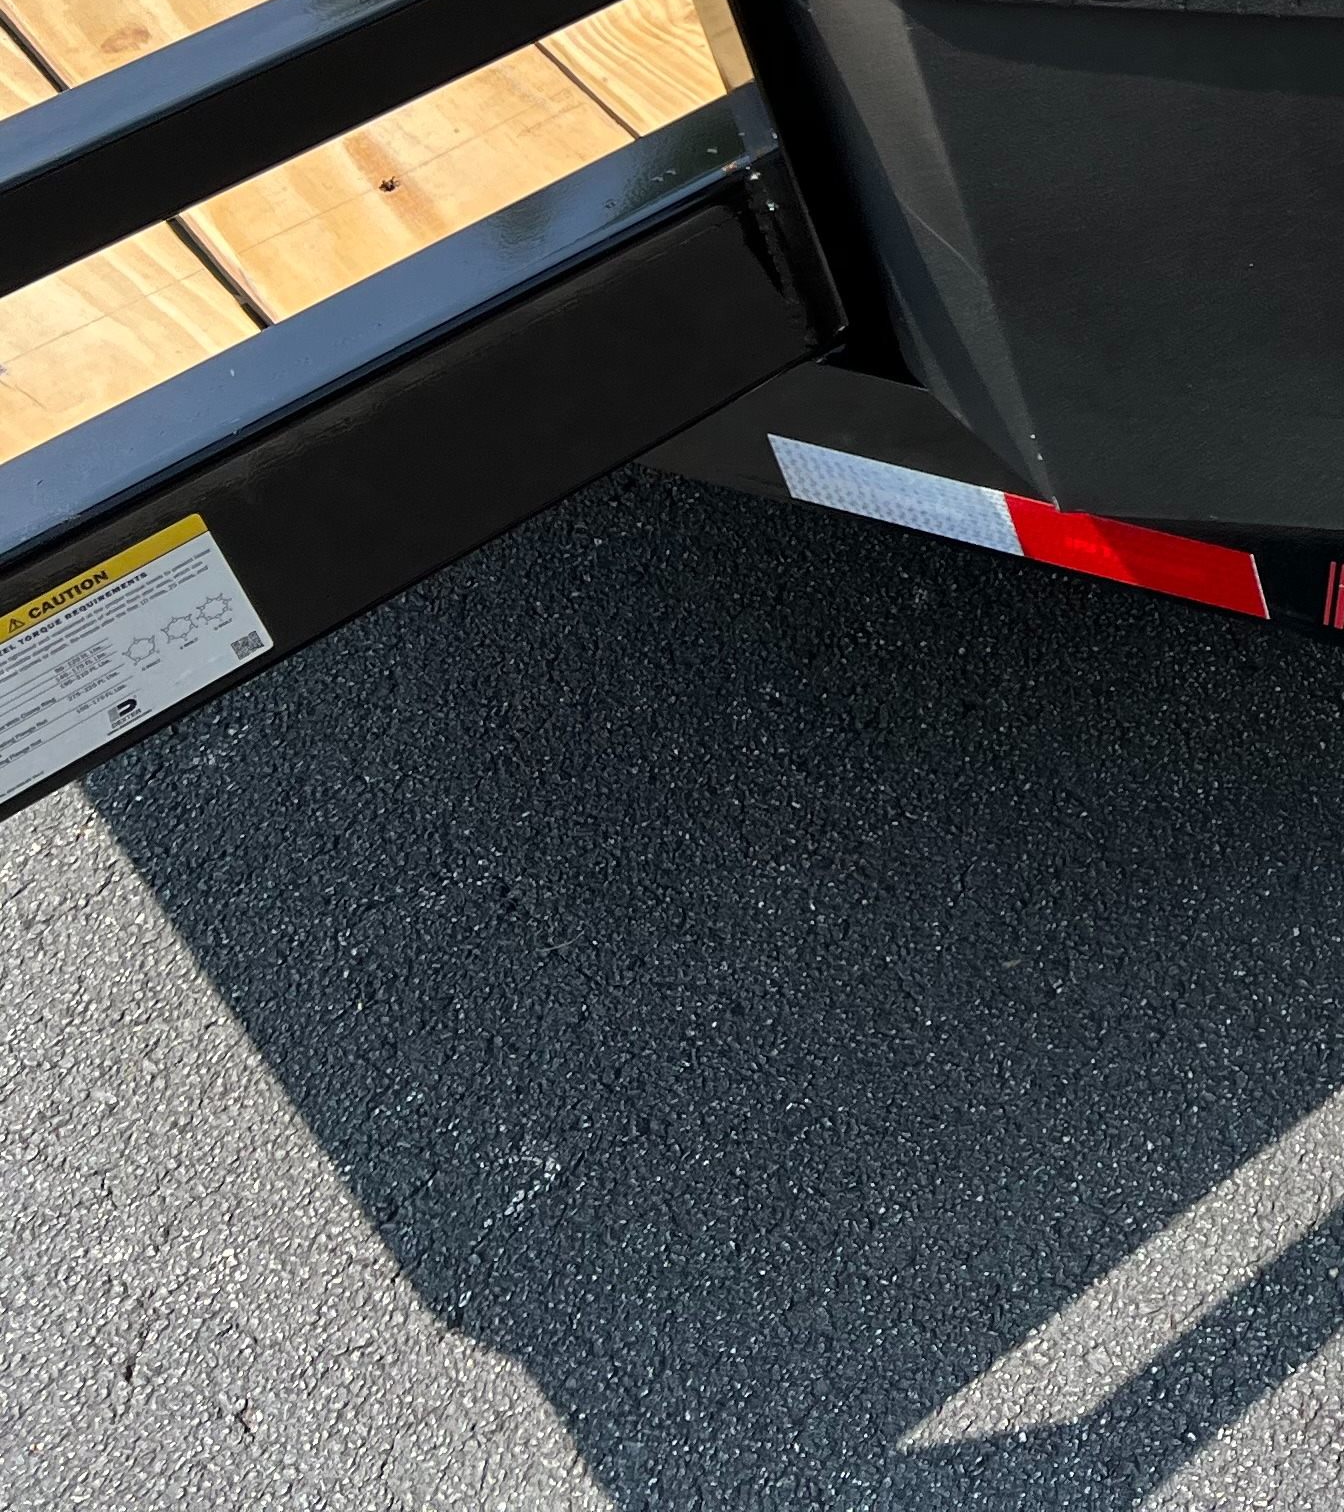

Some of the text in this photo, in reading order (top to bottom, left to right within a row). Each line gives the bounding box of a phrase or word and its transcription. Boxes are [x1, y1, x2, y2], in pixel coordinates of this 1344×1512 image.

[18, 618, 62, 645] TORQUE
[64, 571, 148, 620] REQUIREMENTS
[28, 569, 109, 619] CAUTION
